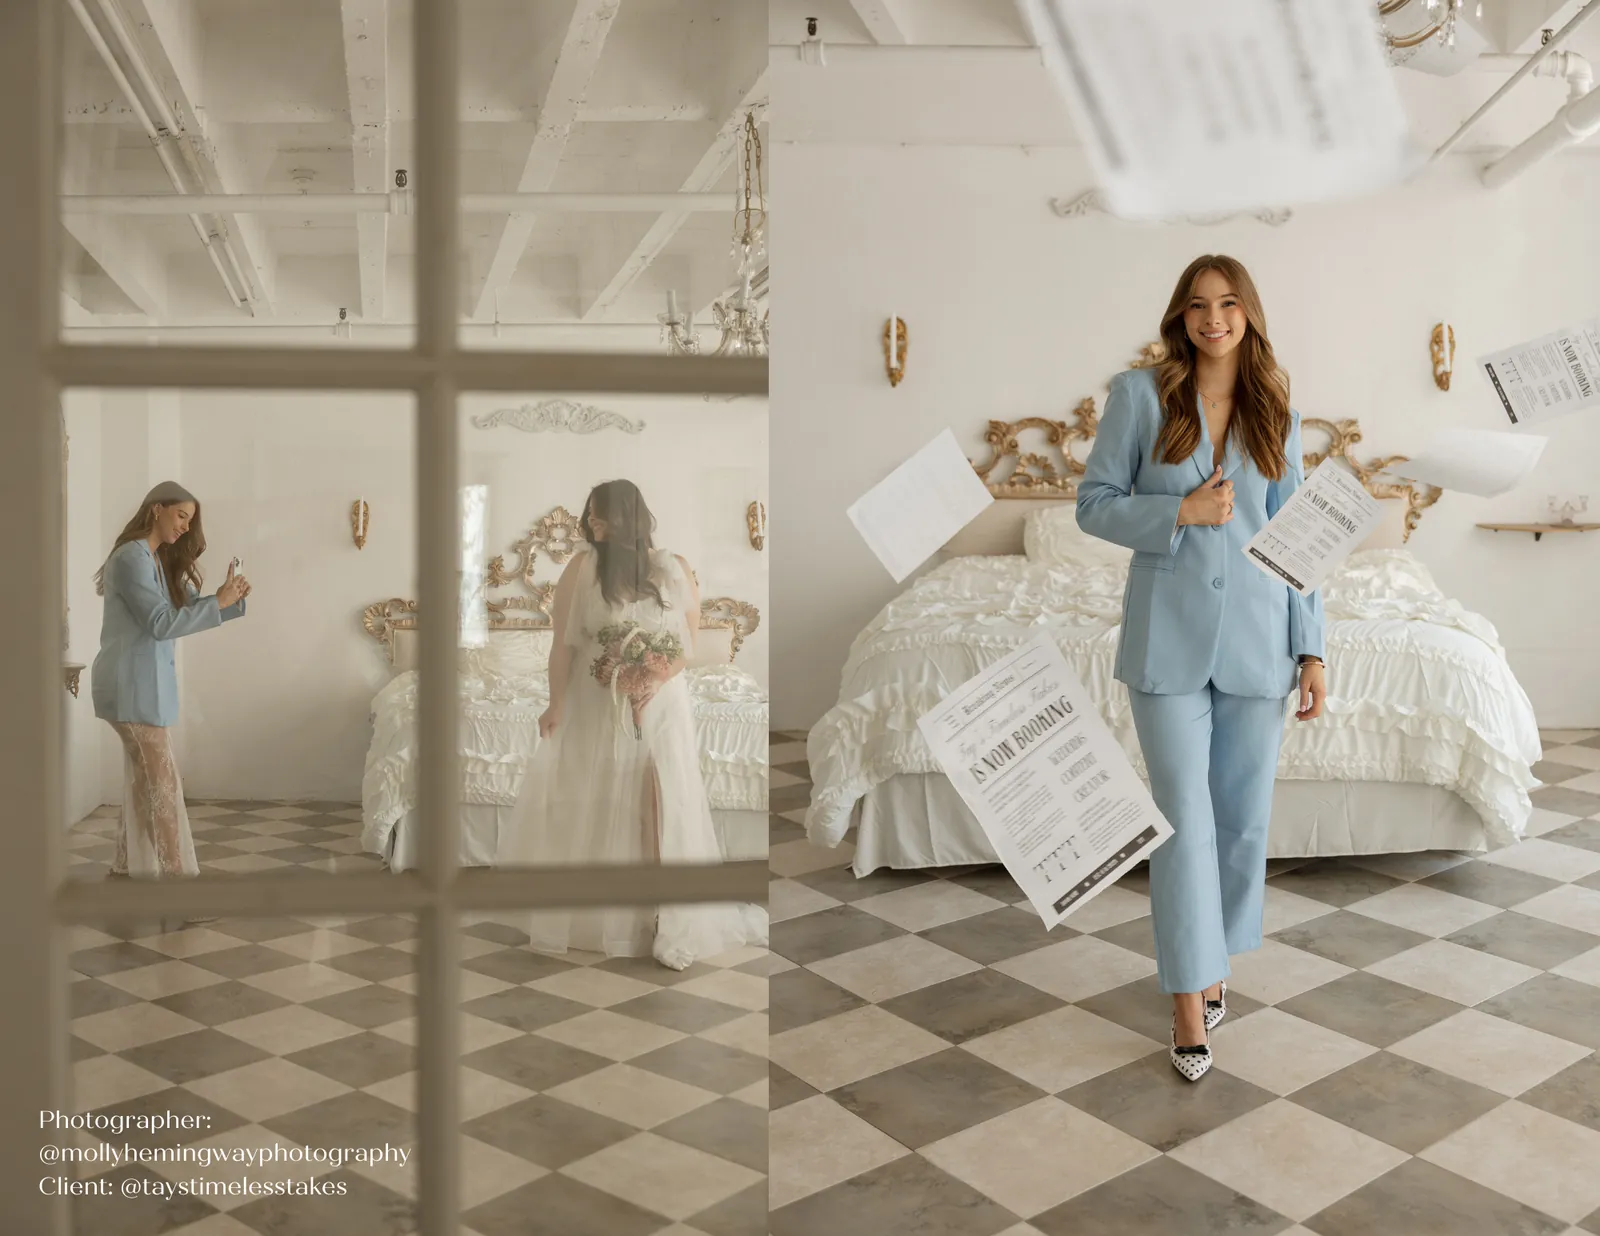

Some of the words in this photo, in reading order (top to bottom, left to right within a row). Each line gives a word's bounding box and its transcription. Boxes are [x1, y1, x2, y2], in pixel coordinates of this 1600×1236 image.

[1570, 362, 1594, 398] BOOKING
[1311, 493, 1329, 510] NOW
[1326, 505, 1359, 534] BOOKING
[969, 763, 987, 785] IS
[981, 738, 1016, 771] NOW
[1011, 695, 1073, 750] BOOKING
